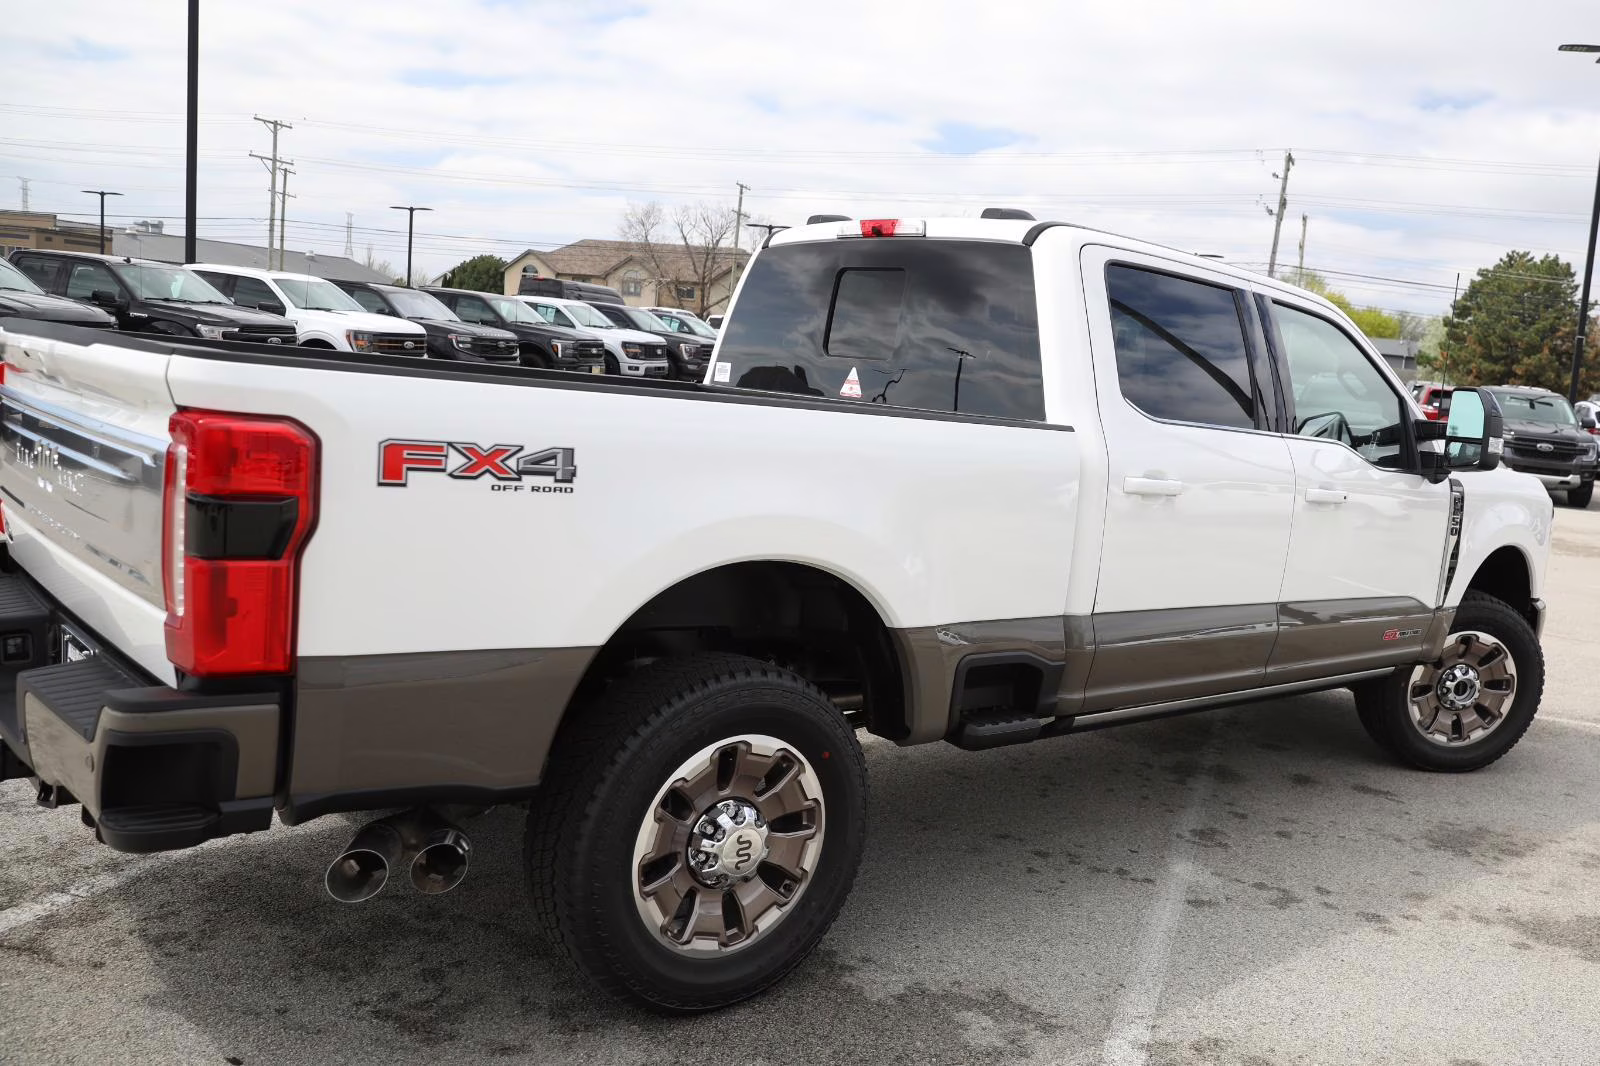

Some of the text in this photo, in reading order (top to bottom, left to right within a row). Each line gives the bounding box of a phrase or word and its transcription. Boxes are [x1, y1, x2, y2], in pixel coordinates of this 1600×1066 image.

[377, 438, 577, 488] FX4
[491, 484, 574, 494] OFF ROAD
